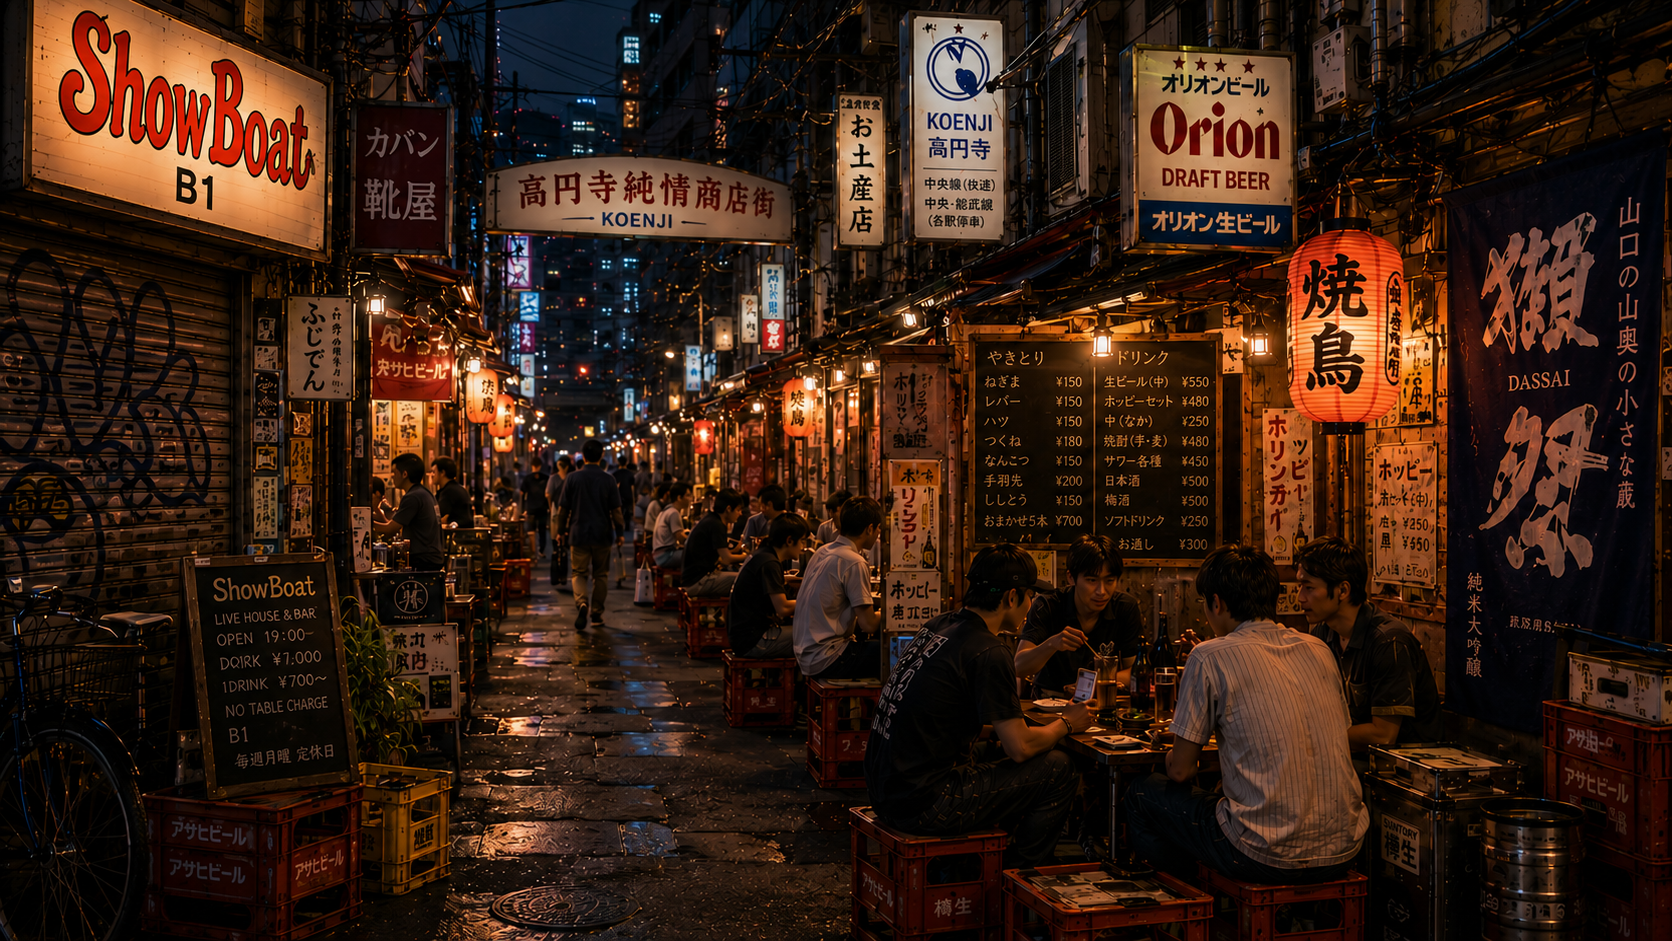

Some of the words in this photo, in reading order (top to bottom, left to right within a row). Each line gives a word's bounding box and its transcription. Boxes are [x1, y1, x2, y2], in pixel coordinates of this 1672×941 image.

[1162, 74, 1270, 97] オリオンビール
[58, 10, 314, 190] ShowBoat
[927, 112, 993, 132] KOENJI
[1150, 101, 1280, 160] Orion
[365, 126, 440, 158] カバン
[928, 137, 991, 160] 高円寺
[849, 114, 875, 233] お土産店
[1162, 168, 1221, 188] DRAFT
[1225, 170, 1270, 191] BEER
[175, 166, 214, 210] B1
[518, 169, 776, 219] 高円寺純情商店街
[364, 178, 438, 222] 靴屋
[601, 212, 673, 228] KOENJI
[1152, 210, 1281, 235] オリオン生ビール
[1301, 253, 1368, 394] 焼鳥
[302, 302, 326, 392] ふじでん
[1616, 197, 1641, 509] 山口の山奥の小さな蔵
[987, 351, 1044, 366] やきとり
[1117, 351, 1169, 366] ドリンク
[984, 375, 1021, 389] ねぎま
[1056, 376, 1083, 388] ¥150
[1104, 375, 1169, 389] 生ビール(中)
[1181, 376, 1210, 388] ¥550
[1508, 369, 1571, 392] DASSAI
[985, 396, 1021, 408] レバー
[1056, 396, 1083, 408] ¥150
[1104, 395, 1174, 408] ホッピーセット
[1181, 396, 1210, 408] ¥480
[983, 416, 1009, 428] ハツ
[1056, 416, 1083, 428] ¥150
[1181, 415, 1210, 428] ¥250
[984, 435, 1022, 448] つくね
[1056, 435, 1083, 448] ¥180
[1181, 435, 1210, 448] ¥480
[984, 455, 1030, 468] なんこつ
[1056, 455, 1083, 468] ¥150
[1103, 454, 1162, 468] サワー各種
[1181, 455, 1209, 468] ¥450
[983, 474, 1024, 488] 手羽先
[1056, 475, 1083, 488] ¥200
[1104, 474, 1140, 488] 日本酒
[1181, 475, 1209, 488] ¥500
[985, 493, 1028, 507] ししとう
[1056, 495, 1083, 508] ¥150
[1104, 494, 1130, 507] 梅酒
[1181, 495, 1209, 507] ¥500
[1056, 515, 1083, 528] ¥700
[1104, 515, 1165, 527] ソフトドリンク
[1180, 515, 1209, 528] ¥250
[1118, 537, 1154, 551] お通し
[1178, 538, 1208, 551] ¥300
[212, 575, 316, 602] ShowBoat
[214, 612, 241, 626] LIVE
[243, 609, 281, 623] HOUSE
[216, 632, 253, 646] OPEN
[225, 704, 245, 718] NO
[248, 700, 284, 715] TABLE
[286, 696, 328, 712] CHARGE
[229, 726, 249, 744] B1
[234, 748, 292, 769] 毎週月曜
[296, 744, 335, 763] 定休日
[1564, 766, 1630, 803] アサヒビール
[170, 820, 248, 846] アサヒビール
[1383, 817, 1419, 841] SUNTORY
[168, 857, 247, 885] アサヒビール
[294, 849, 345, 881] アサヒビール
